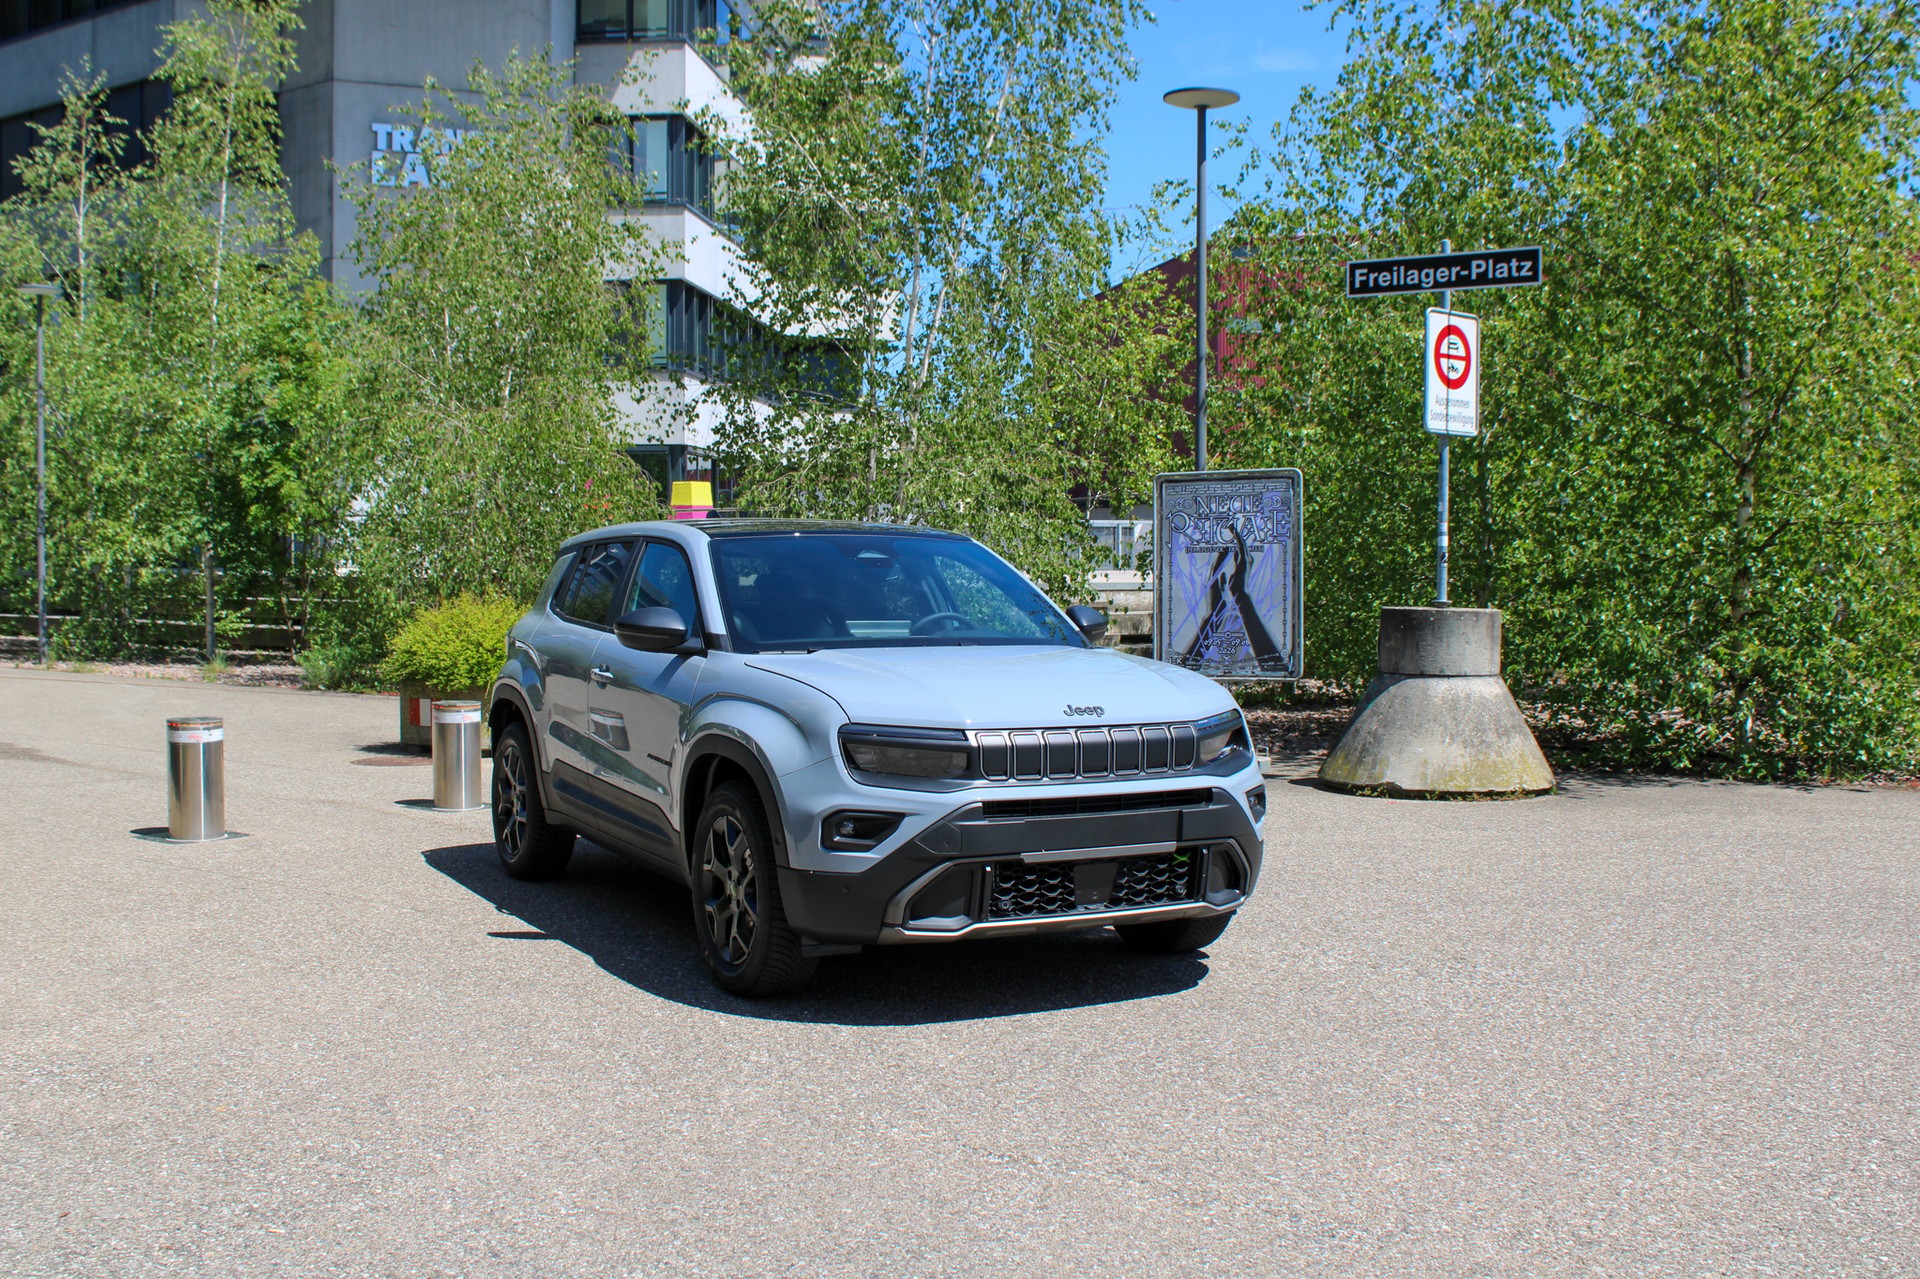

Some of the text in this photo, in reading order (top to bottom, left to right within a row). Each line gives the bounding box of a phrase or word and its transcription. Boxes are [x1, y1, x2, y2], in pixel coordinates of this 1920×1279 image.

[1354, 257, 1533, 288] Freilager-Platz
[1192, 495, 1264, 514] NEUE
[1063, 704, 1105, 718] Jeep
